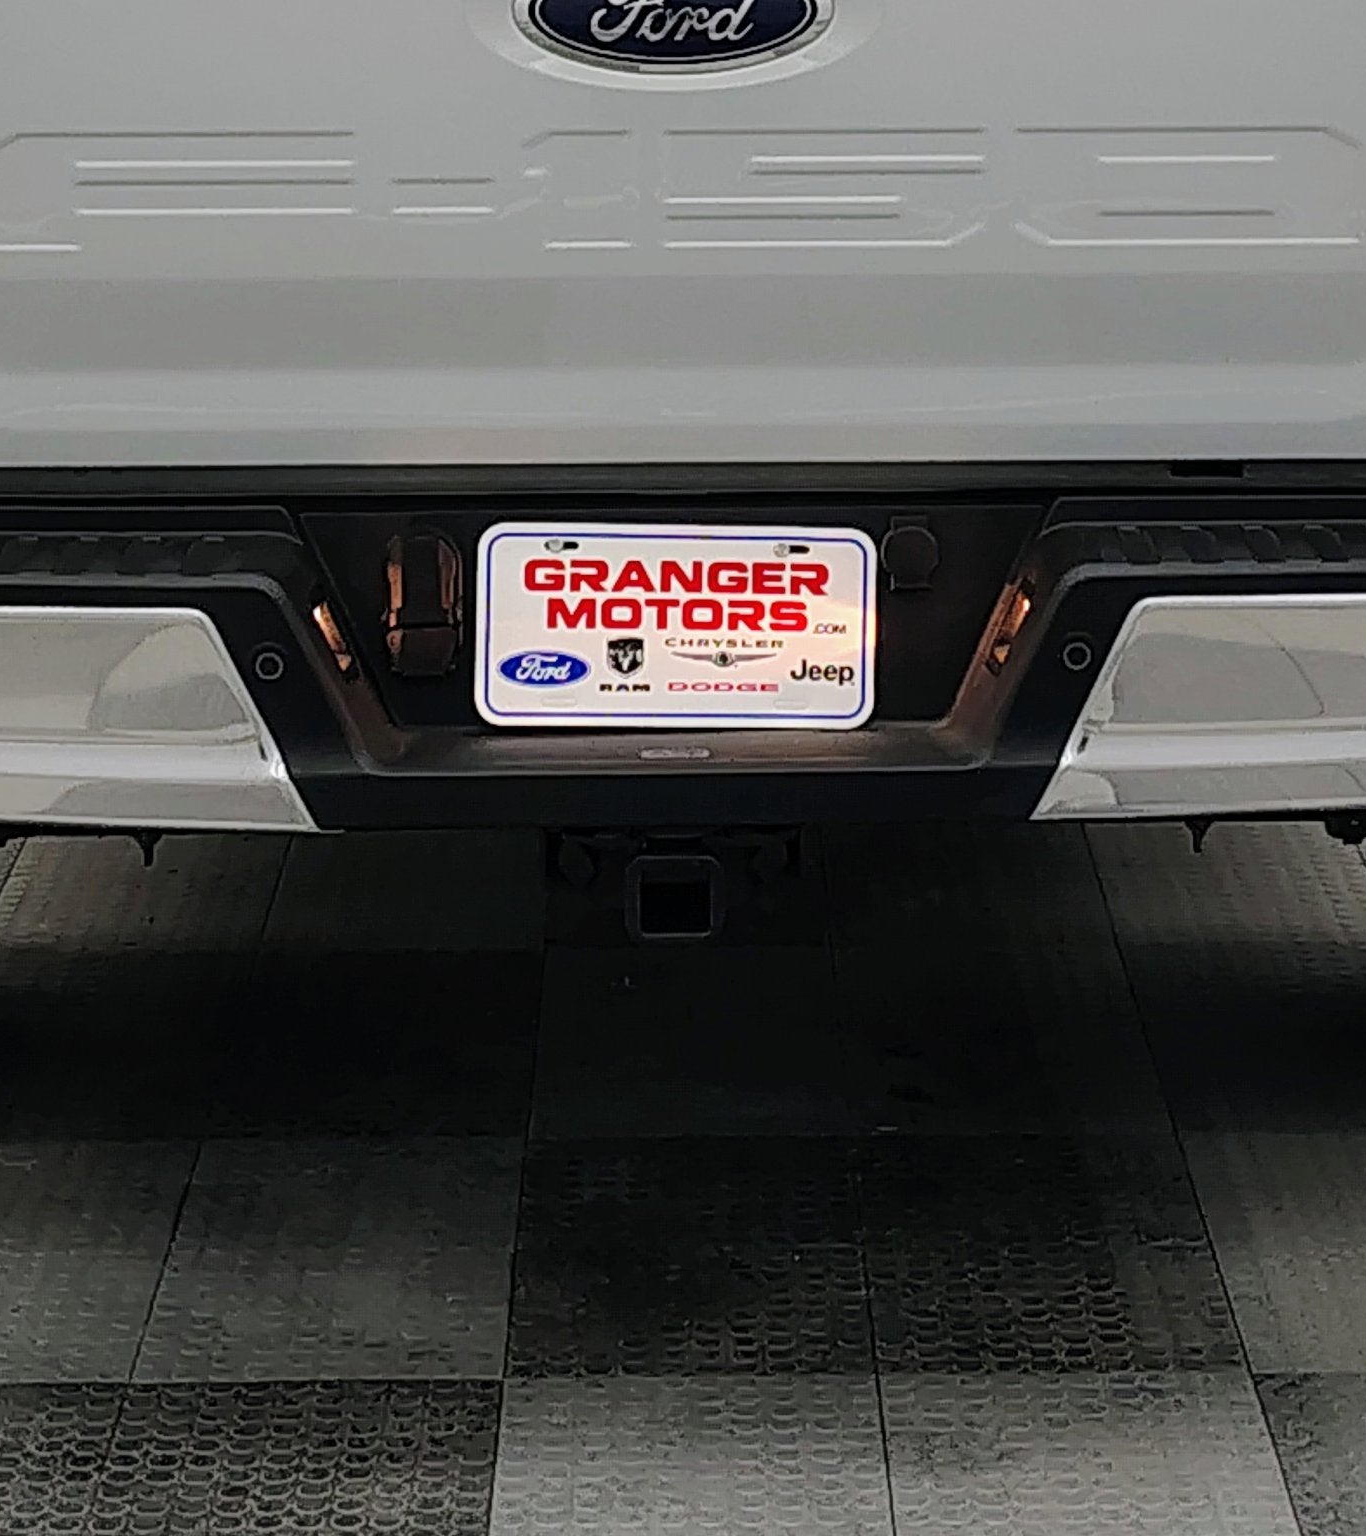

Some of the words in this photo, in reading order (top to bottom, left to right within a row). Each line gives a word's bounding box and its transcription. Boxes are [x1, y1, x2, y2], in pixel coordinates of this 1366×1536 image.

[524, 559, 830, 596] GRANGER
[547, 598, 808, 632] MOTORS
[664, 638, 785, 649] CHRYSLER
[515, 655, 571, 681] Ford
[790, 659, 854, 686] Jeep
[599, 683, 651, 693] RAM
[667, 681, 780, 693] DODGE
